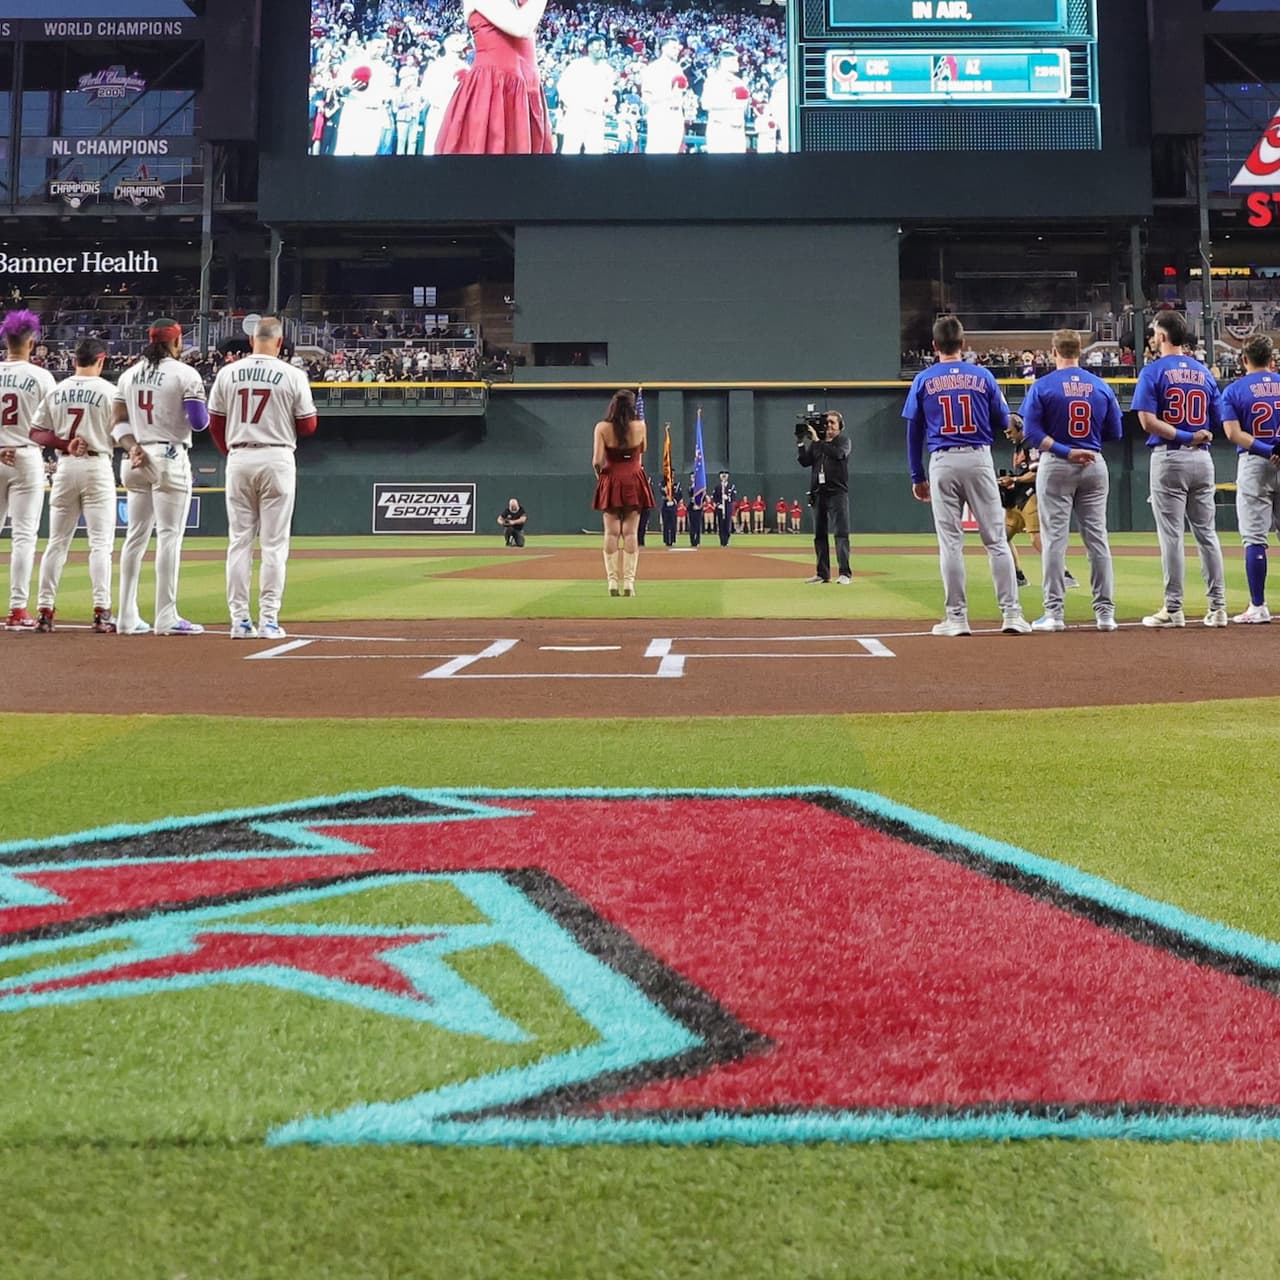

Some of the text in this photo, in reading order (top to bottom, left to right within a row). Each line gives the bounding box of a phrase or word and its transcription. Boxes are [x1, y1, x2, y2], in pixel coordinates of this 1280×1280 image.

[912, 1, 932, 18] IN
[44, 22, 181, 36] WORLD CHAMPIONS
[52, 140, 168, 156] NL CHAMPIONS
[81, 250, 159, 273] Health
[232, 368, 283, 385] LOVULLO
[925, 373, 987, 395] COUNSELL
[55, 389, 102, 407] CARROLL
[1063, 381, 1093, 397] HAPP
[138, 391, 153, 424] 4
[238, 388, 271, 423] 17
[939, 394, 977, 435] 11
[1163, 387, 1207, 426] 30
[67, 408, 84, 437] 7
[1068, 401, 1091, 438] 8
[385, 493, 460, 503] ARIZONA
[392, 506, 462, 517] SPORTS
